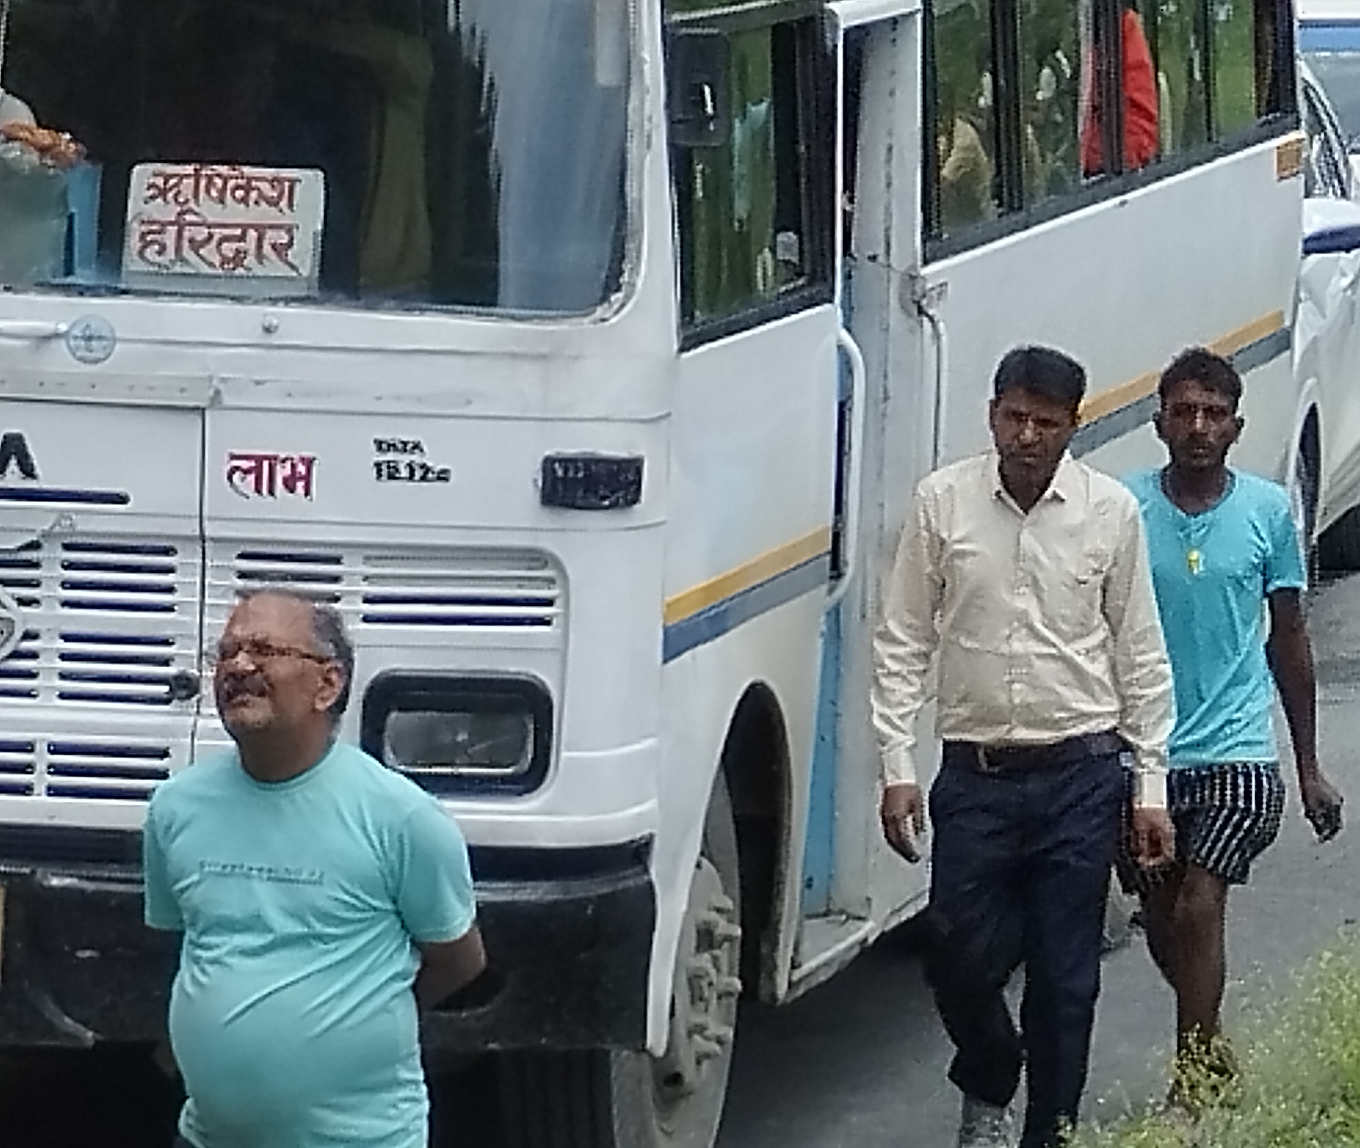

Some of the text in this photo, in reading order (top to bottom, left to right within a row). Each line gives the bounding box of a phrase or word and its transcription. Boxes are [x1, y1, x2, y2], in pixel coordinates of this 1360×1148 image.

[143, 164, 302, 214] ऋषिकेश
[137, 207, 302, 276] हरिद्वार
[226, 452, 316, 501] लाभ
